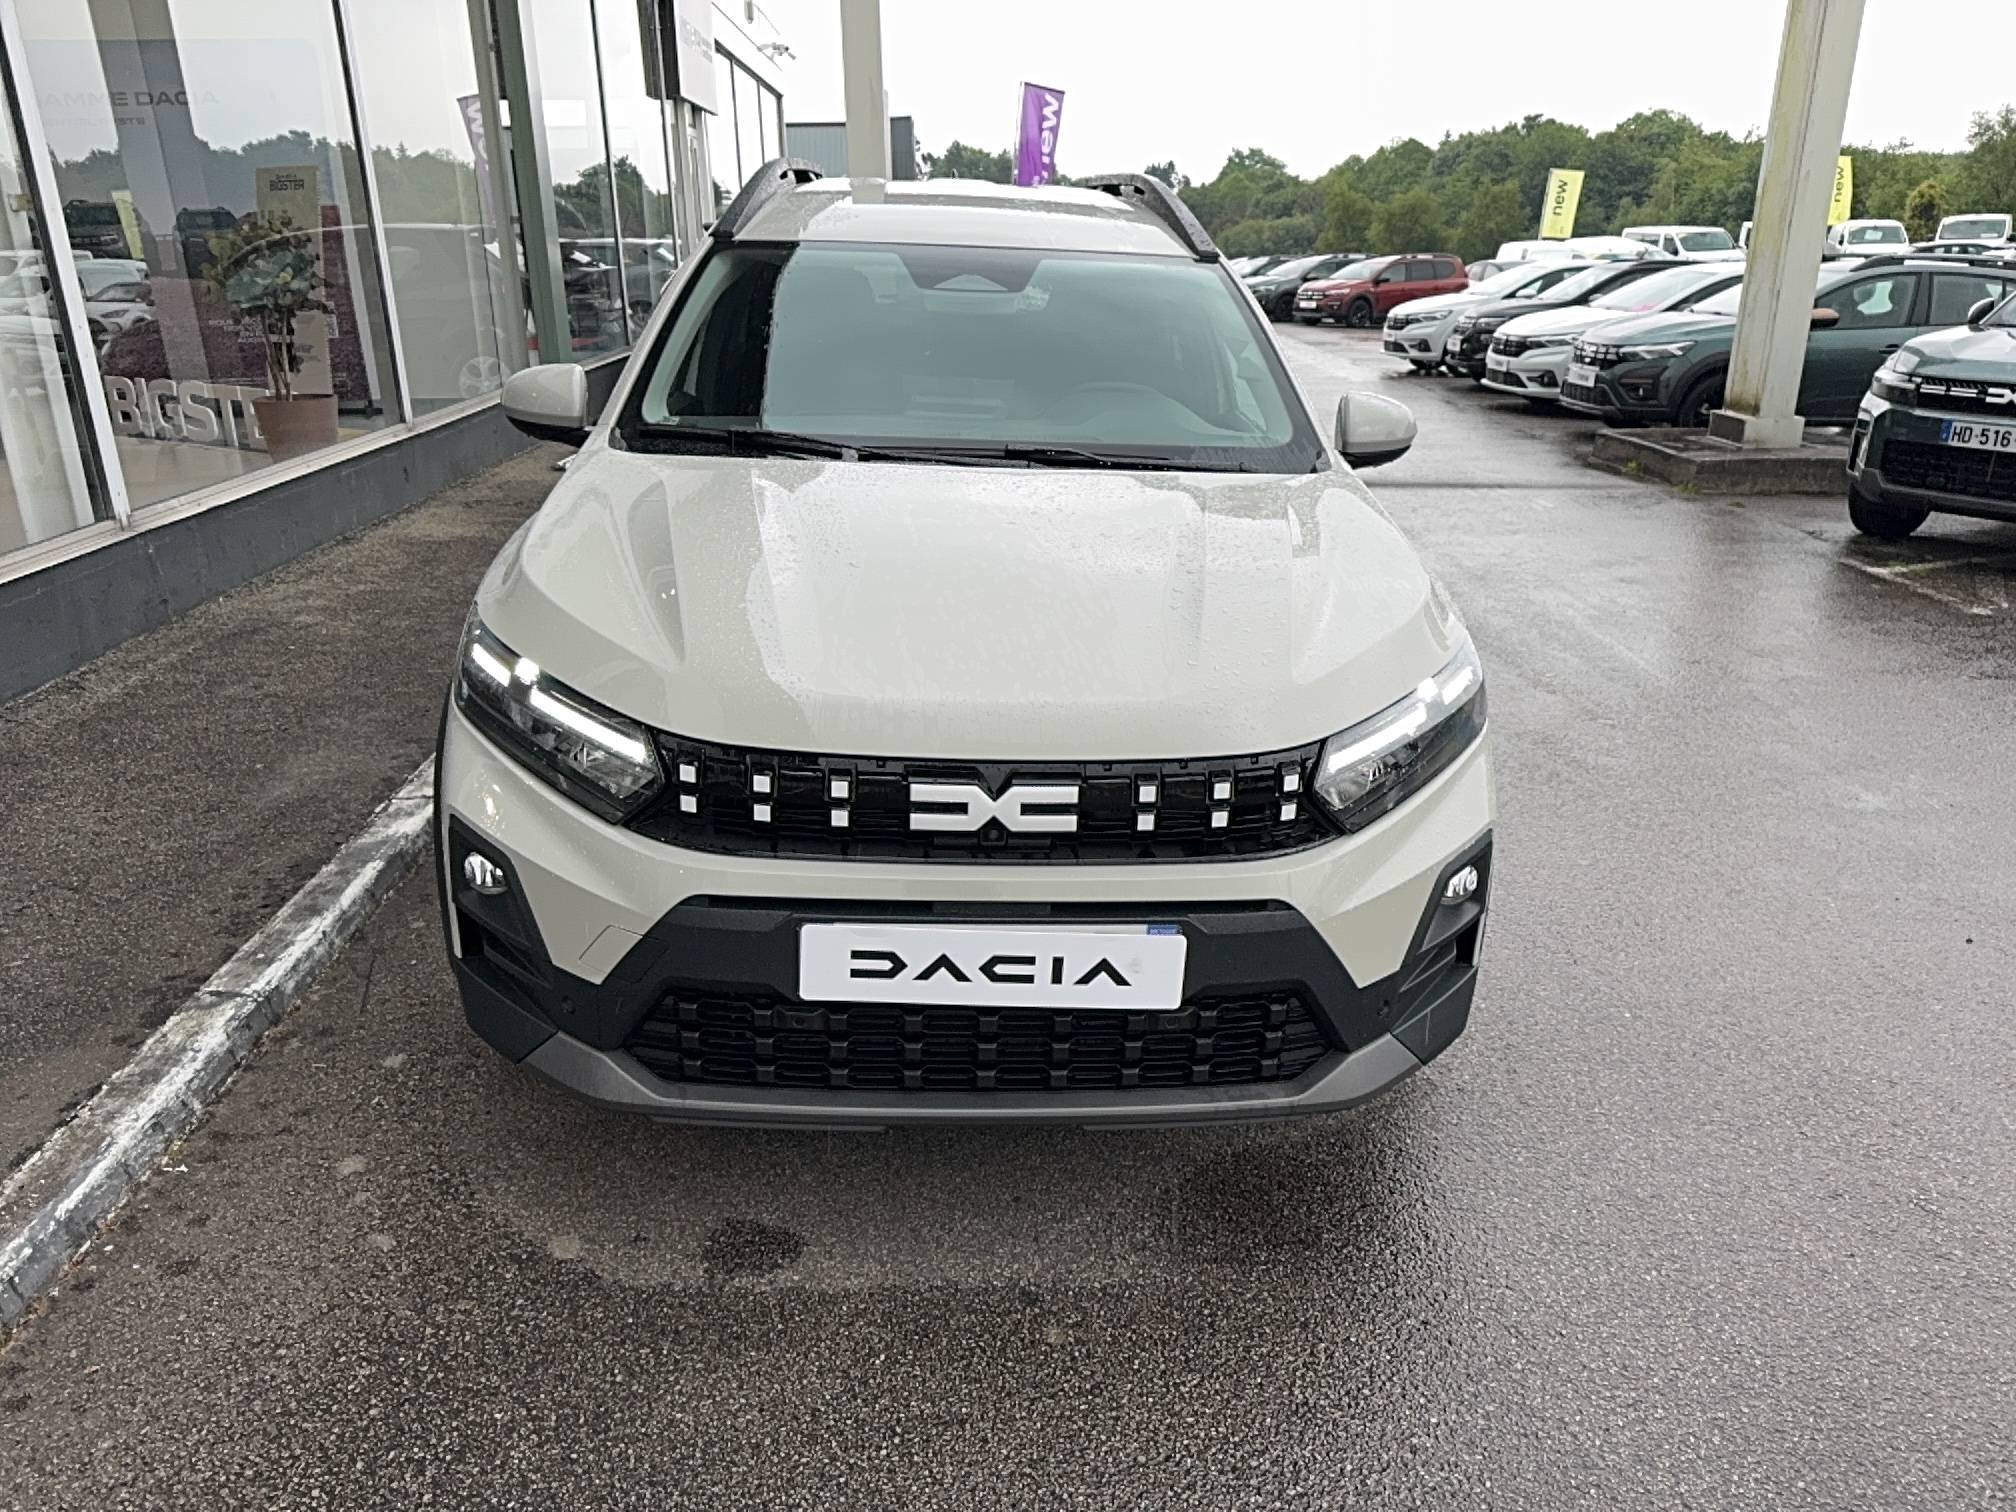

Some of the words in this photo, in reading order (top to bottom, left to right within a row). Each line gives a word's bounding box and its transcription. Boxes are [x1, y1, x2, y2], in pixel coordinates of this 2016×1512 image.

[1552, 179, 1568, 216] new
[1834, 166, 1845, 203] new
[849, 949, 1132, 987] DACIA
